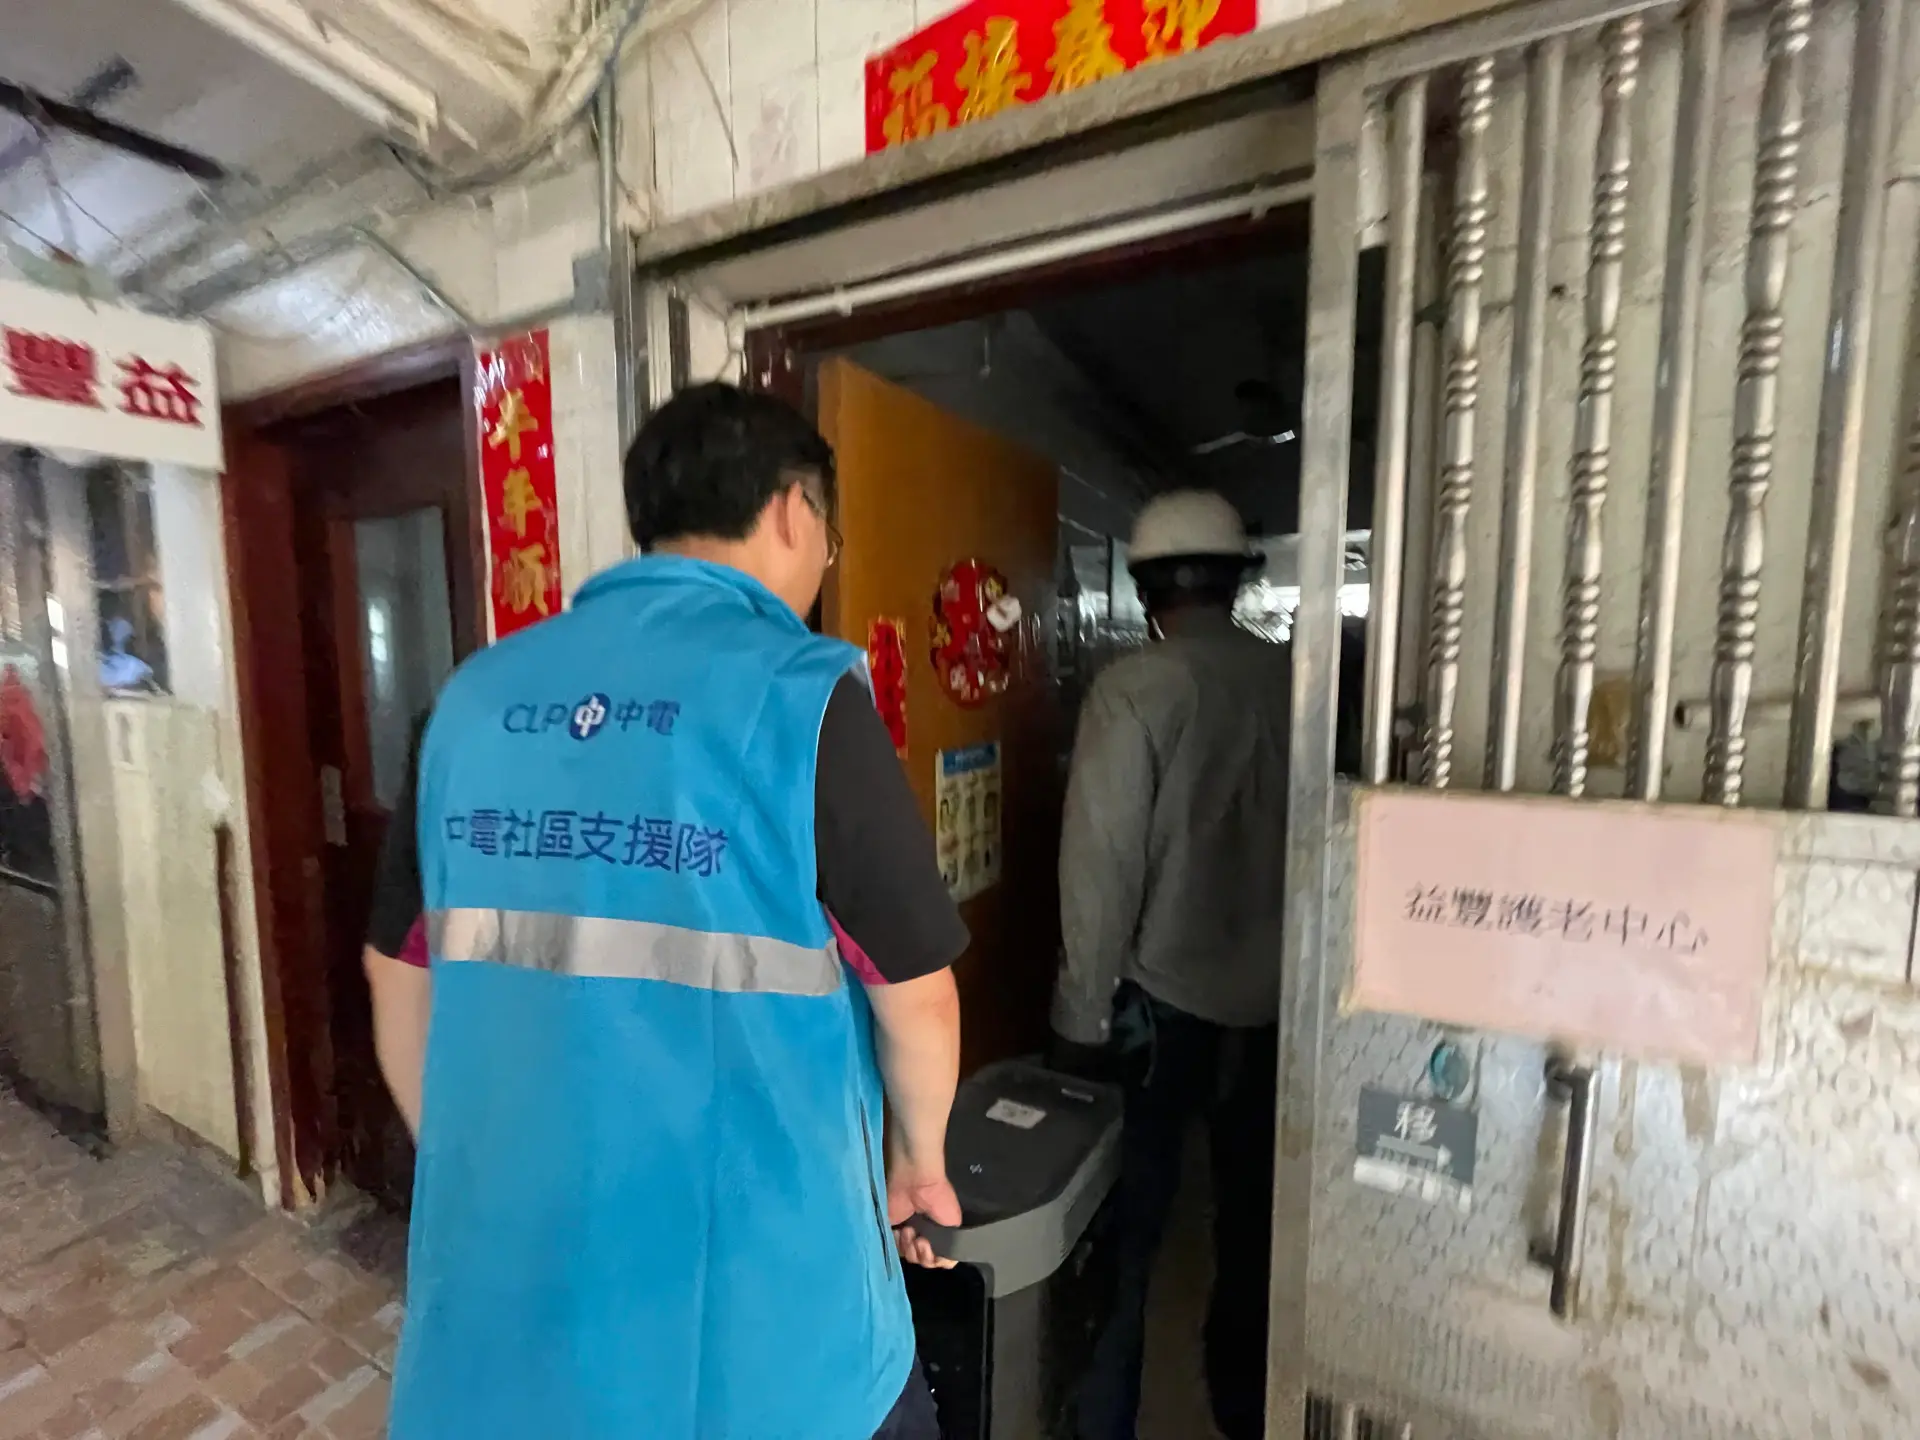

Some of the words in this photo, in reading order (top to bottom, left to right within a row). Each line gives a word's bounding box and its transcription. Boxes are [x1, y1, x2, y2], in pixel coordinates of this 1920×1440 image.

[503, 703, 568, 734] CLP
[615, 698, 681, 736] 中電
[446, 808, 729, 877] 中電社區支援隊
[1402, 882, 1709, 955] 益豐護老中心
